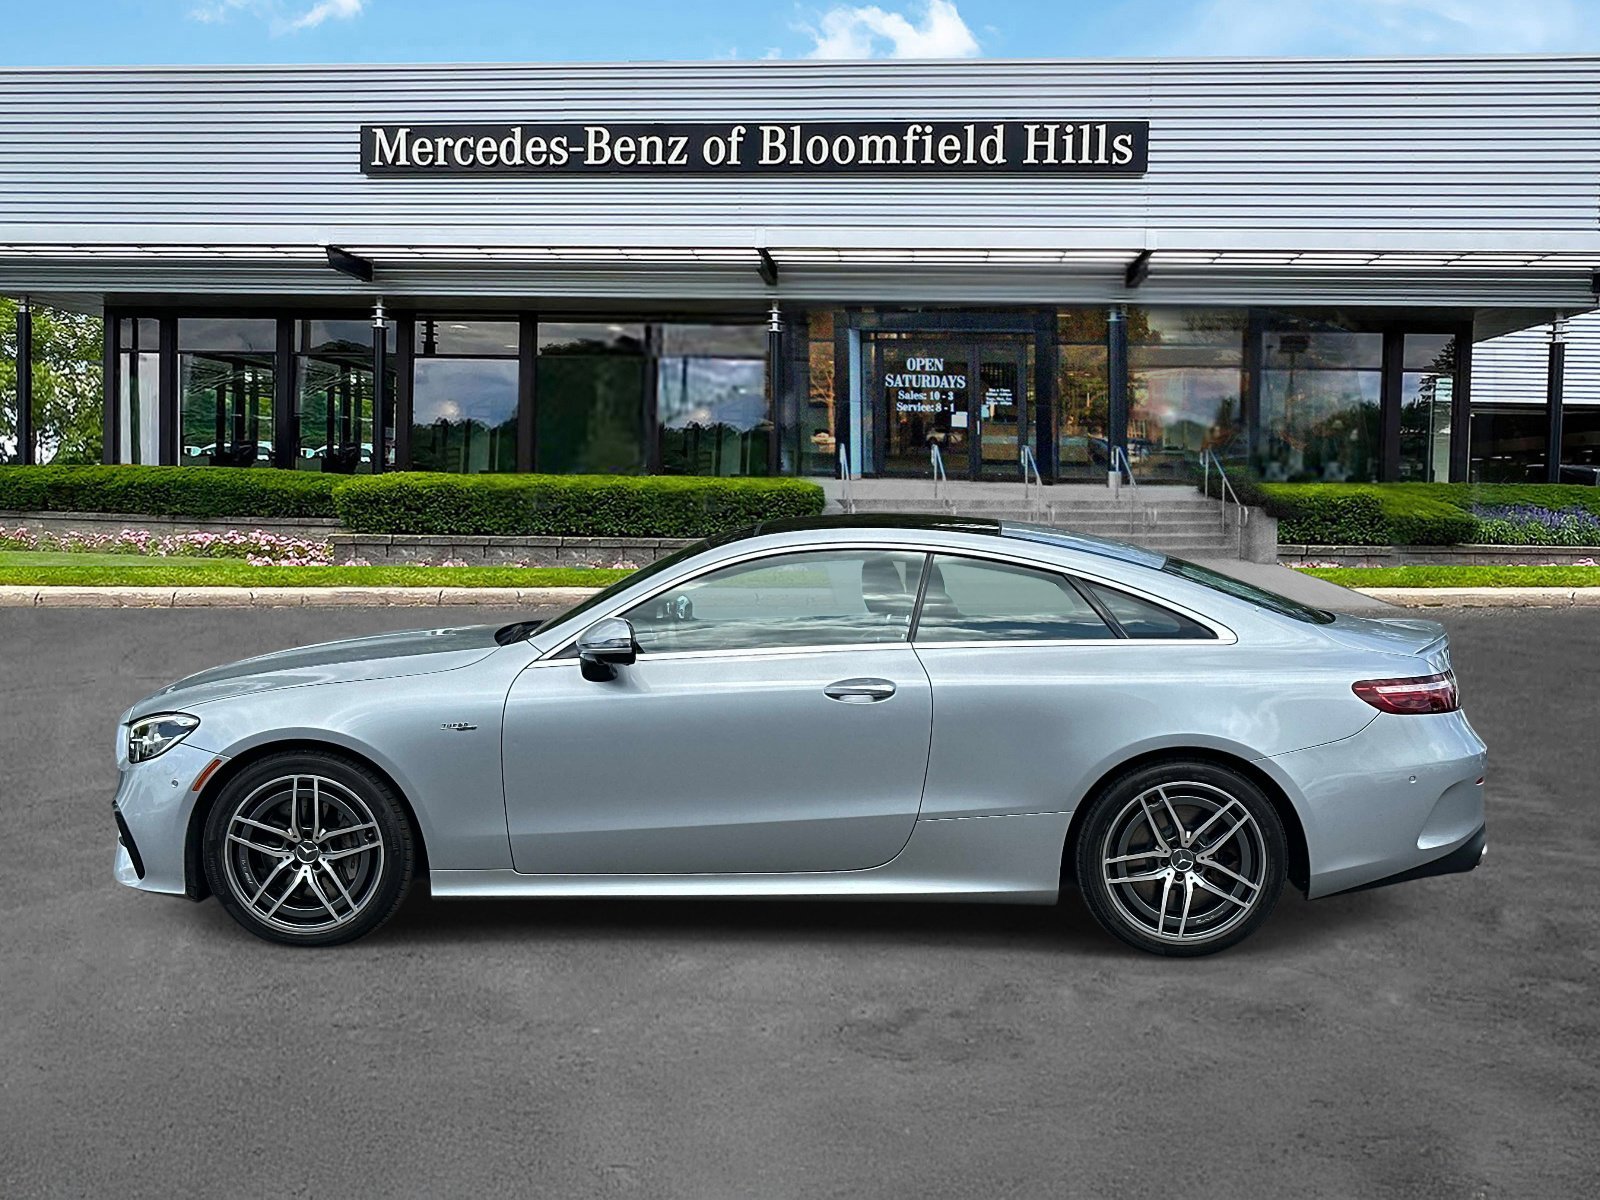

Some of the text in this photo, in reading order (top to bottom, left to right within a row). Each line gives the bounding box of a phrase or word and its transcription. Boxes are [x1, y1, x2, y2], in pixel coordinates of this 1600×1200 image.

[371, 123, 1134, 166] Mercedes-Benz of Bloomfield Hills
[906, 357, 944, 372] OPEN
[885, 374, 966, 389] SATURDAYS
[898, 390, 927, 400] Sales:
[930, 391, 940, 400] 10
[947, 391, 954, 400] 3
[896, 402, 934, 412] Service:
